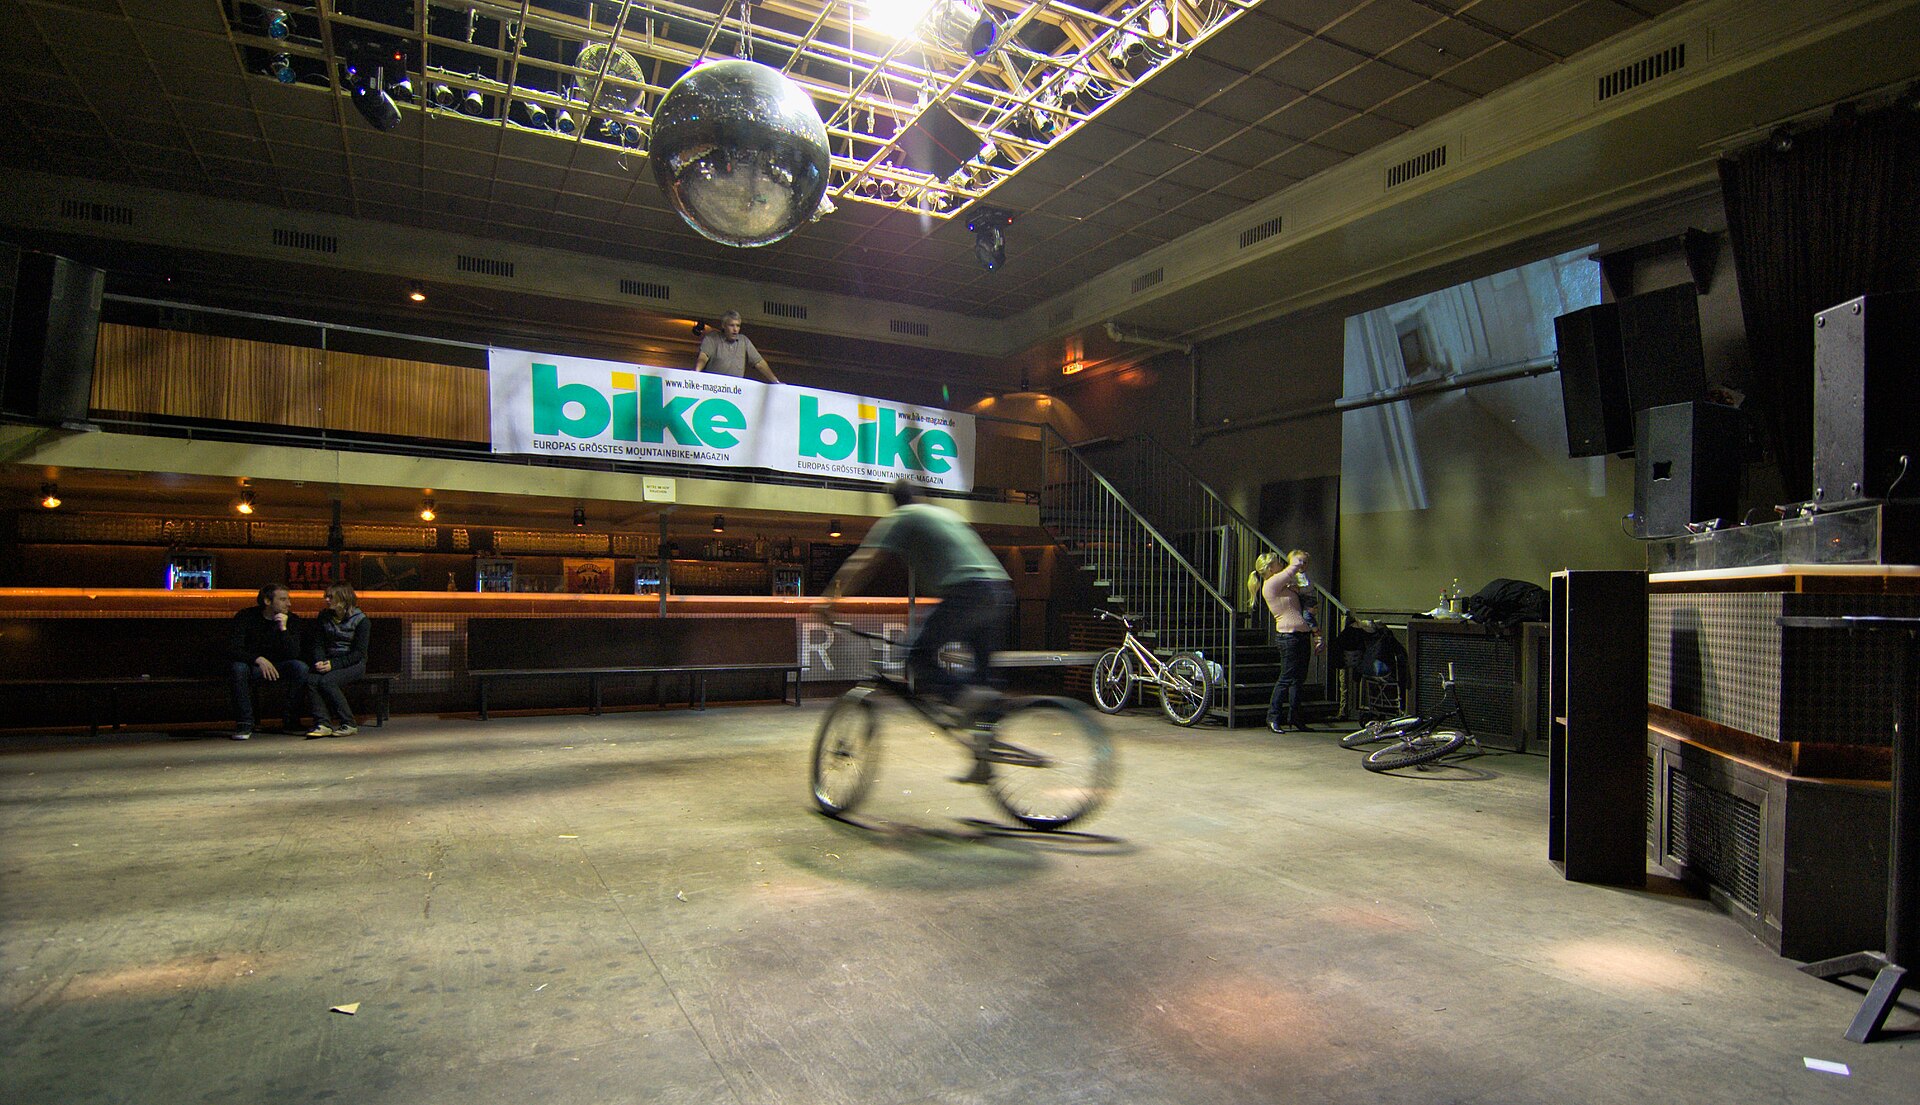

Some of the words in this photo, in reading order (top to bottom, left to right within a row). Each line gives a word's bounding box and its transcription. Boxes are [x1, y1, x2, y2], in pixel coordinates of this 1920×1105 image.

[665, 378, 742, 395] www.bike-magazin.de
[531, 362, 747, 449] bike
[898, 411, 956, 428] www.bike-magazin.de
[798, 394, 958, 474] bike
[533, 439, 576, 451] EUROPAS
[578, 441, 624, 455] GRÖSSTES
[625, 446, 730, 462] MOUNTAINBIKE-MAGAZIN
[797, 460, 830, 472] EUROPAS
[831, 463, 866, 476] GRÖSSTES
[866, 468, 944, 485] MOUNTAINBIKE-MAGAZIN
